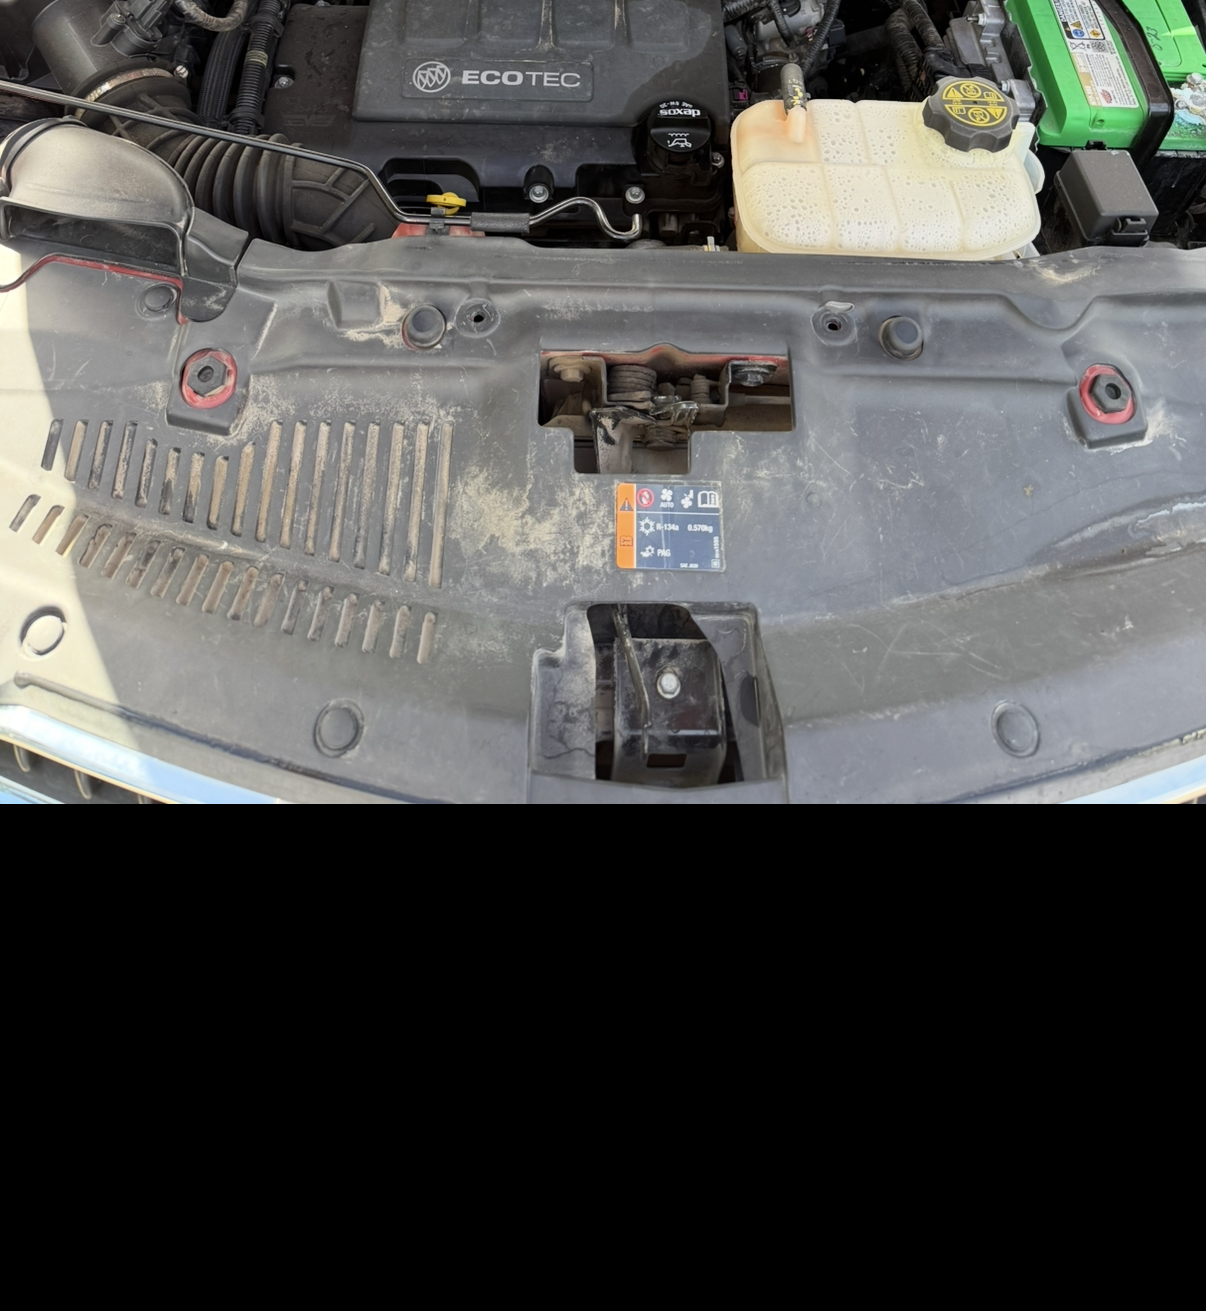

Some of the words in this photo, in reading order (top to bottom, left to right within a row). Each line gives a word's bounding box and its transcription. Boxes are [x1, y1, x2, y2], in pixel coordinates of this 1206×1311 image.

[462, 70, 581, 88] ECOTEC
[659, 109, 701, 118] dexos
[660, 501, 674, 509] AUTO
[656, 522, 680, 532] R-134a
[657, 549, 671, 557] PAG
